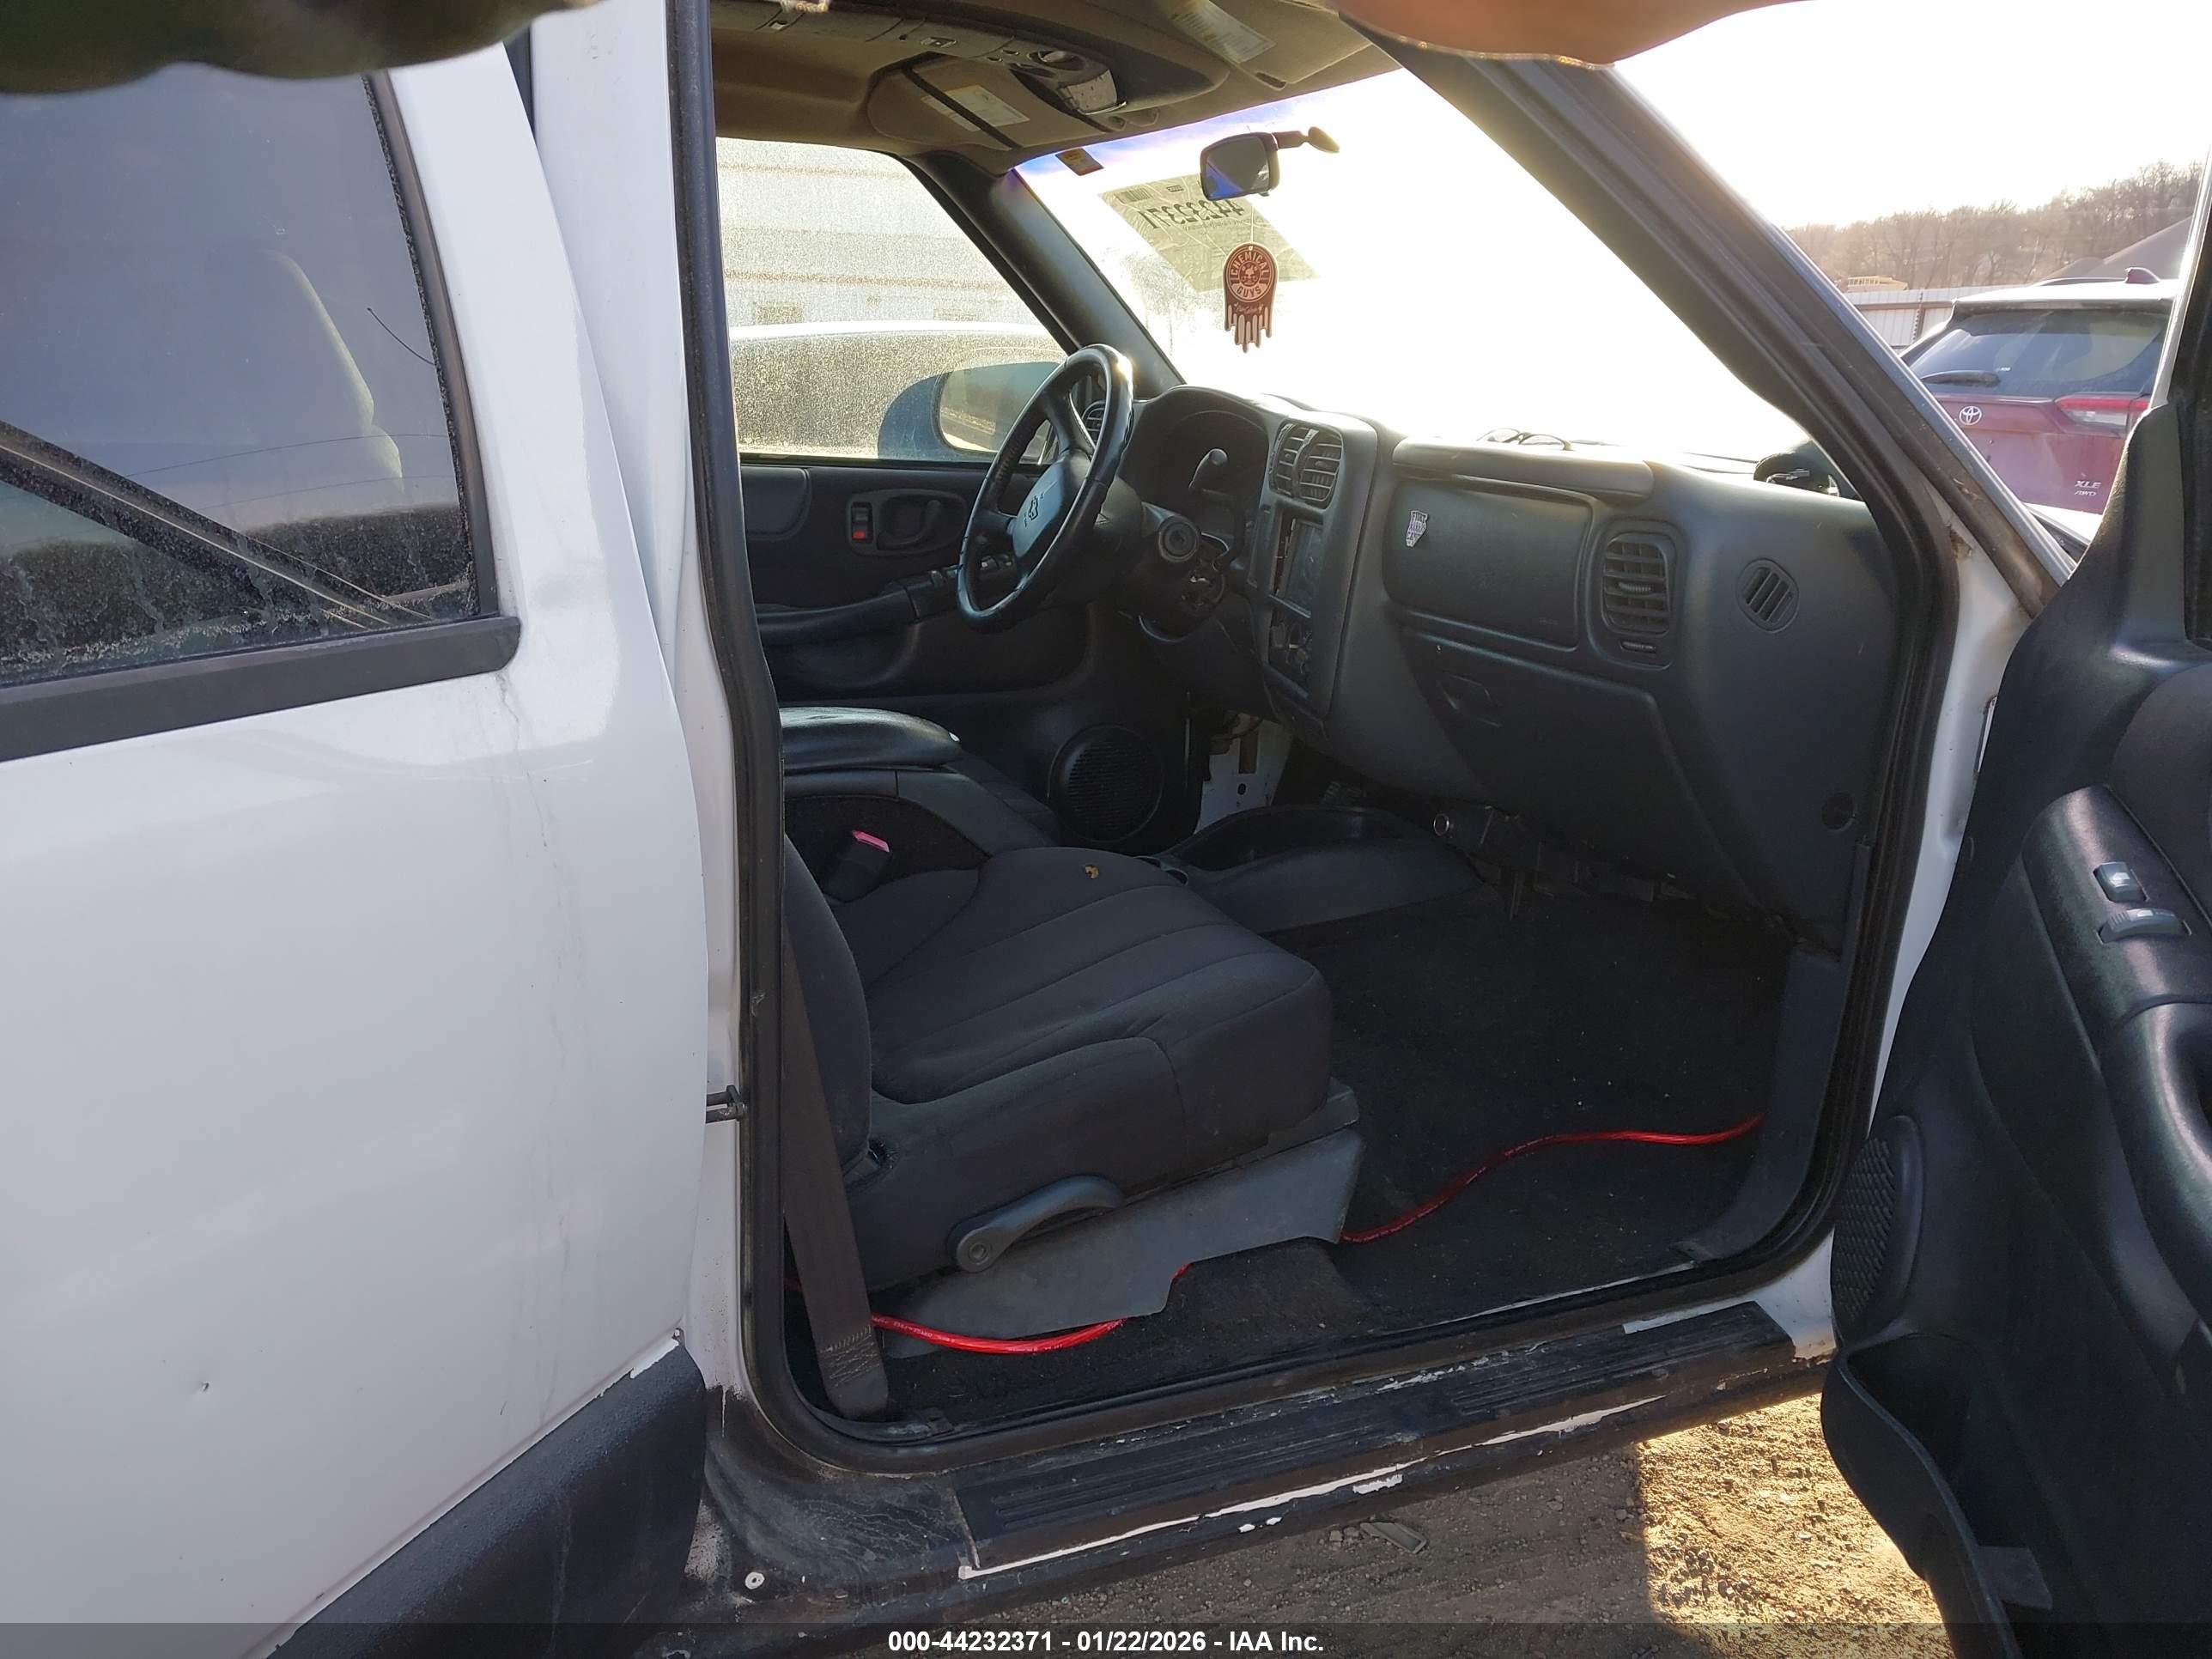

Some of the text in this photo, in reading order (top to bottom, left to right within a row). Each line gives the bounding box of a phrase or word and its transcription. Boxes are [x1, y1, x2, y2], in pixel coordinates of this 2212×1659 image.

[1231, 251, 1270, 276] CHEMICAL
[1237, 285, 1262, 298] GUYS
[2074, 480, 2103, 489] XLE
